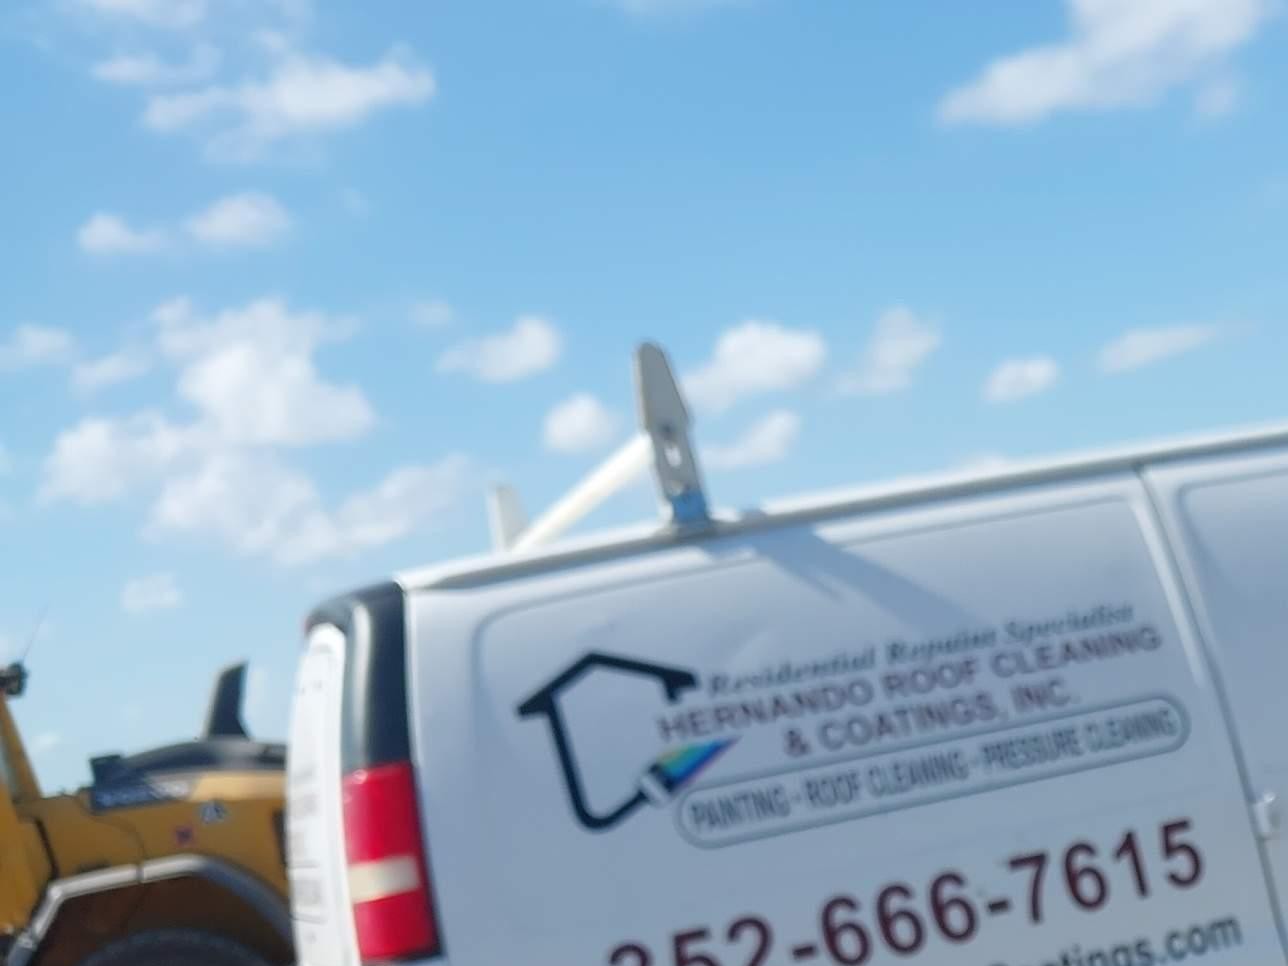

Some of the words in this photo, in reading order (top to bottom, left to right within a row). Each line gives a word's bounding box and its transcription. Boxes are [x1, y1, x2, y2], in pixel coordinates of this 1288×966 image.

[657, 677, 874, 740] HERNANDO
[882, 656, 977, 698] ROOF
[989, 625, 1161, 678] CLEANING
[691, 784, 791, 829] PAINTING
[804, 769, 860, 808] ROOF
[867, 751, 969, 798] CLEANING
[982, 727, 1084, 770] PRESSURE
[1083, 707, 1178, 752] CLEANING
[784, 727, 811, 758] &
